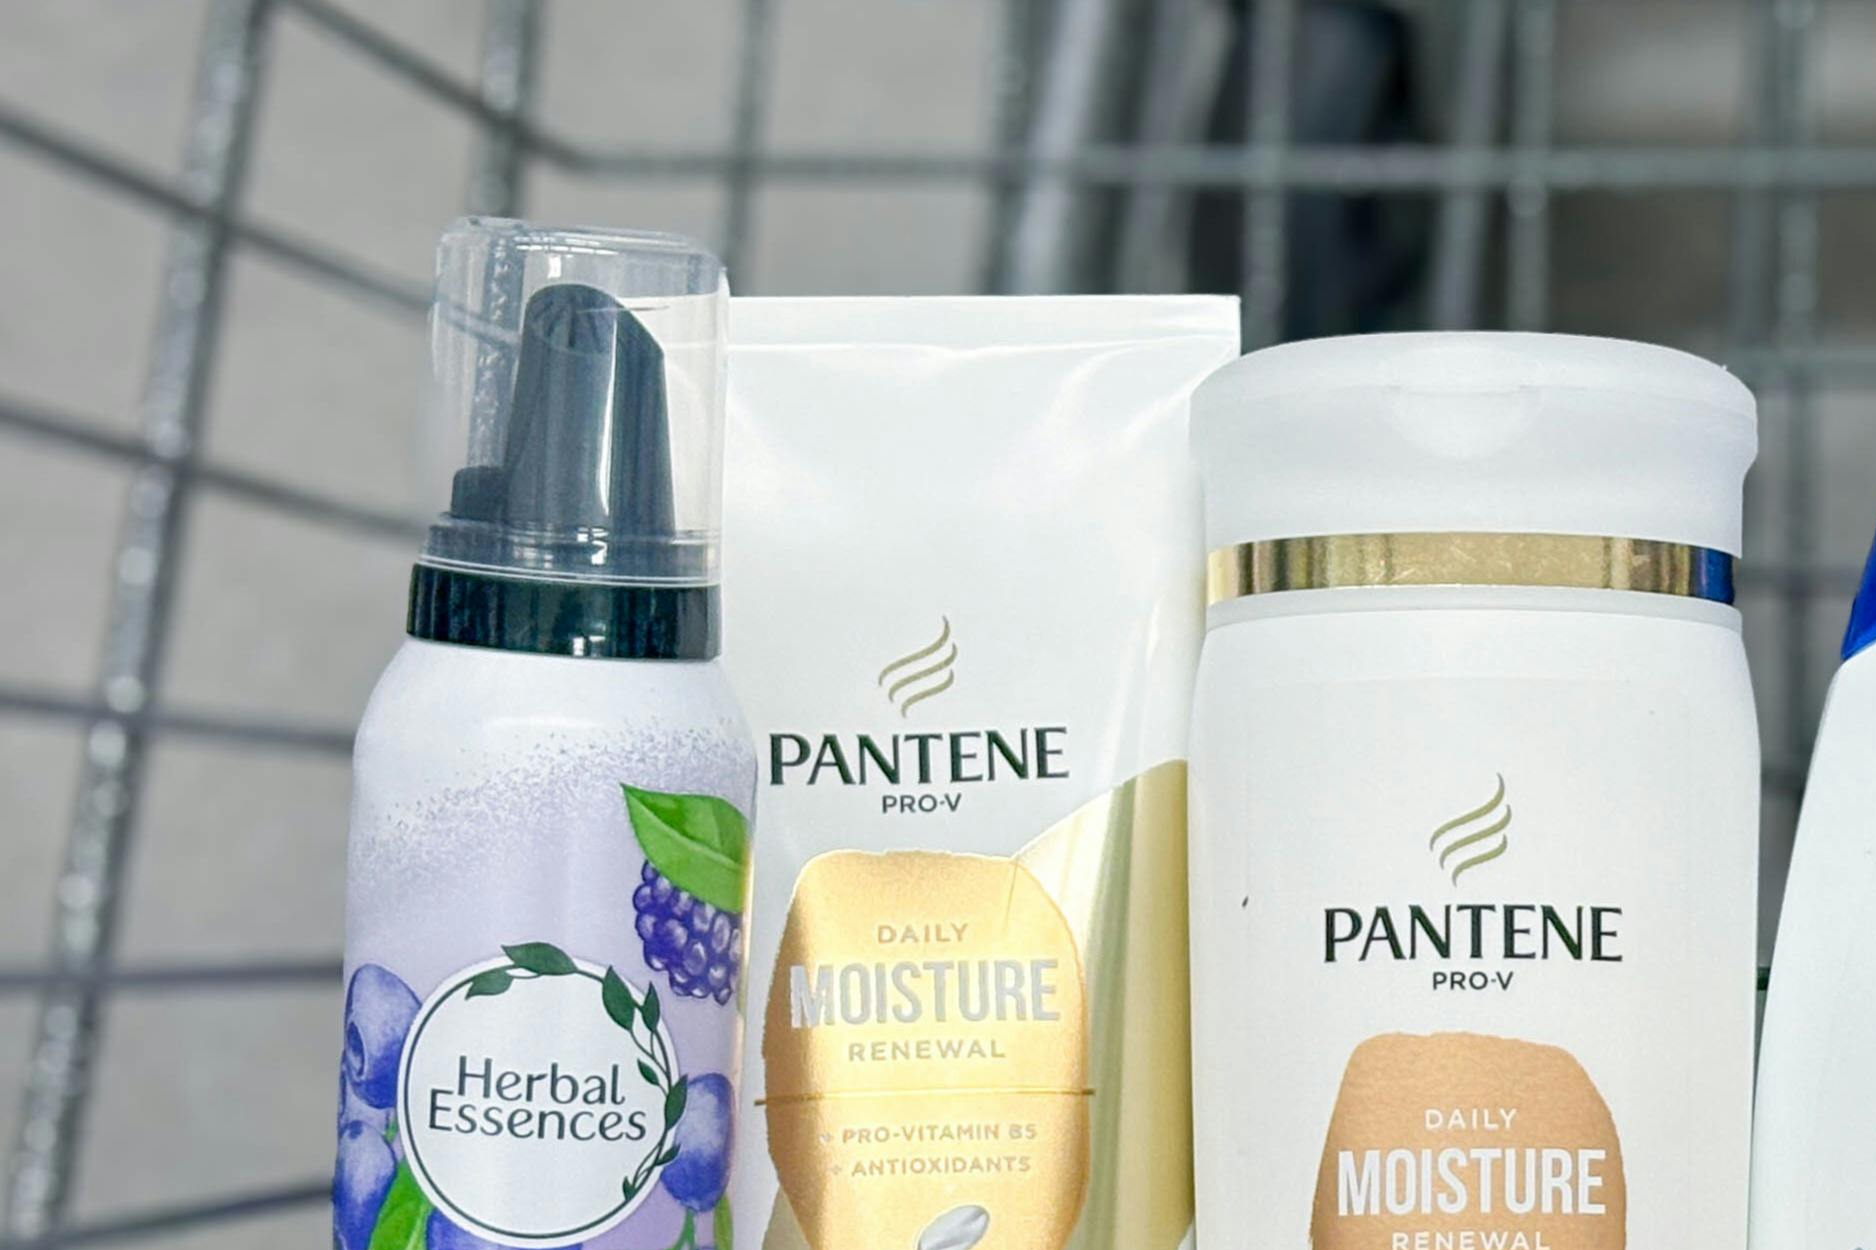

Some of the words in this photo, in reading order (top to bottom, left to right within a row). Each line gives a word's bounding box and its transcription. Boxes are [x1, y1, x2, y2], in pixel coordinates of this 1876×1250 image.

[769, 726, 1069, 786] PANTENE
[882, 793, 962, 814] PRO-V
[877, 922, 969, 944] DAILY
[1323, 904, 1623, 963] PANTENE
[1432, 971, 1514, 991] PRO-V
[789, 958, 1060, 1029] MOISTURE
[849, 1039, 1006, 1062] RENEWAL
[457, 1055, 626, 1105] Herbal
[428, 1088, 647, 1141] Essences
[1425, 1108, 1518, 1130] DAILY
[842, 1124, 999, 1144] PRO-VITAMIN
[851, 1156, 1031, 1177] ANTIOXIDANTS
[1337, 1148, 1606, 1217] MOISTURE
